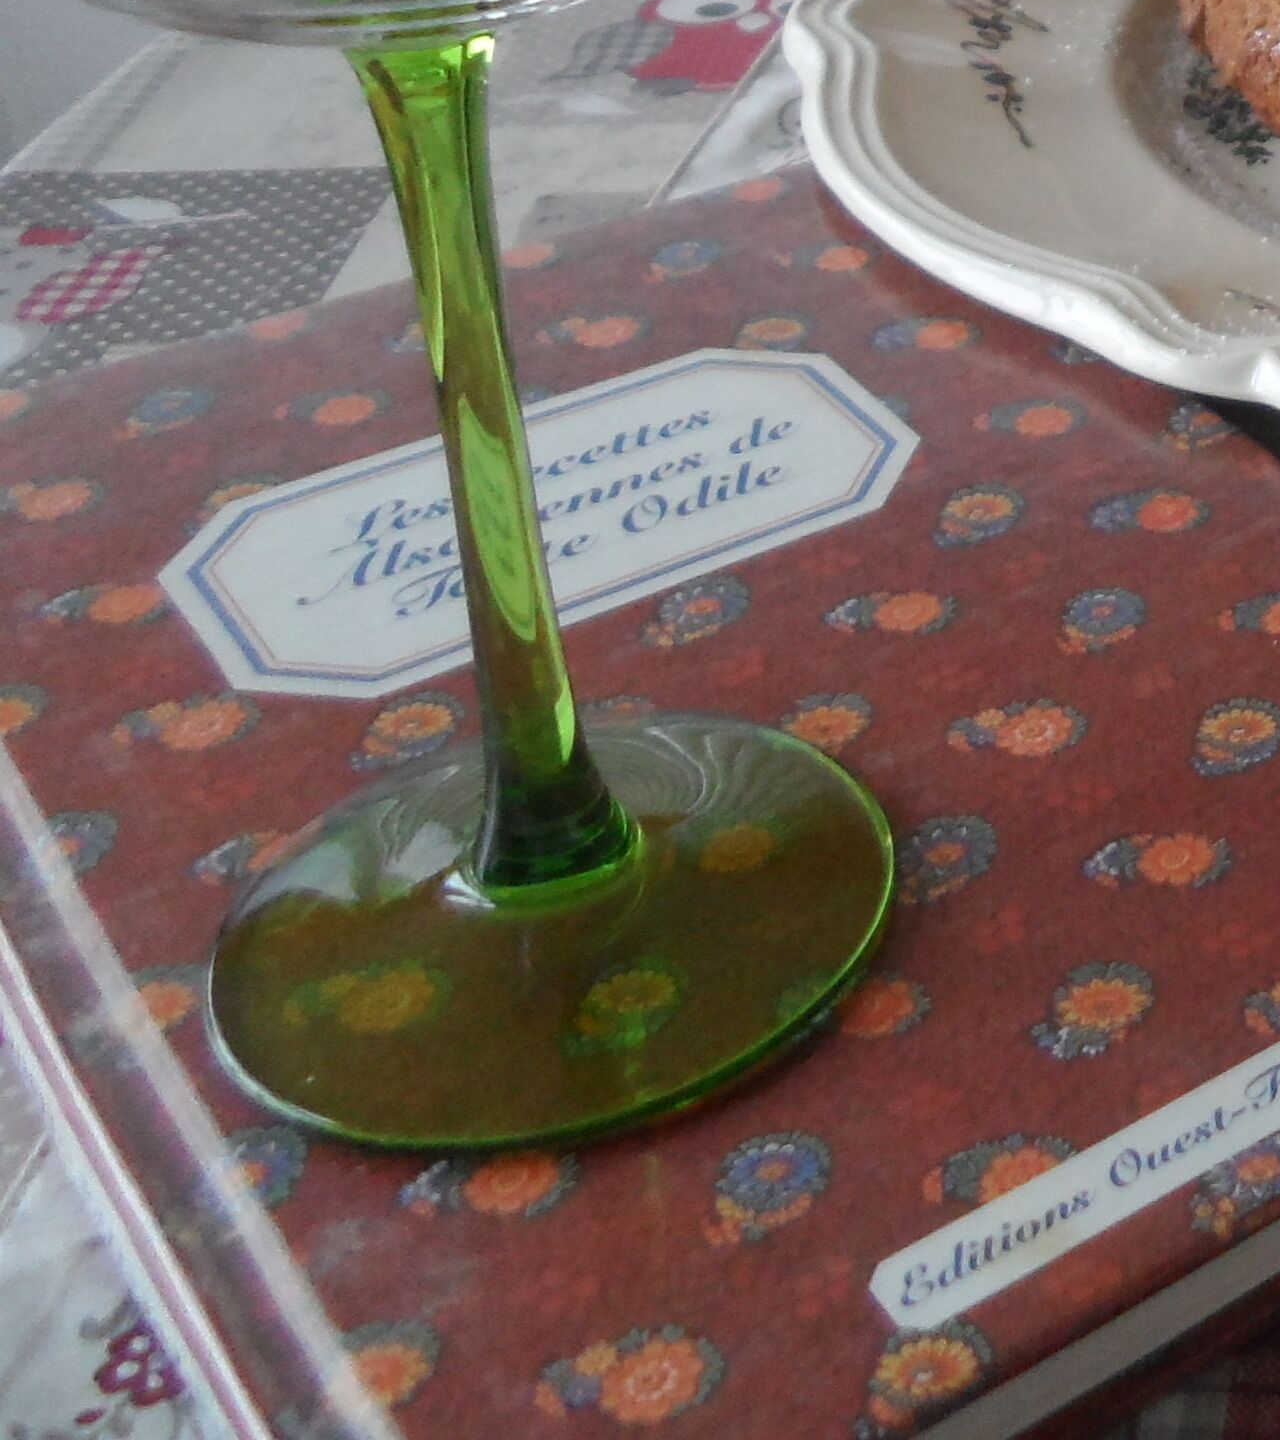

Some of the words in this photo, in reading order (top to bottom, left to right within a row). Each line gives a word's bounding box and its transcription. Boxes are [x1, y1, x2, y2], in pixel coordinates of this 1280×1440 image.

[728, 416, 794, 456] de
[331, 499, 453, 553] Les
[621, 460, 784, 534] Odile
[901, 1185, 1096, 1308] Editions
